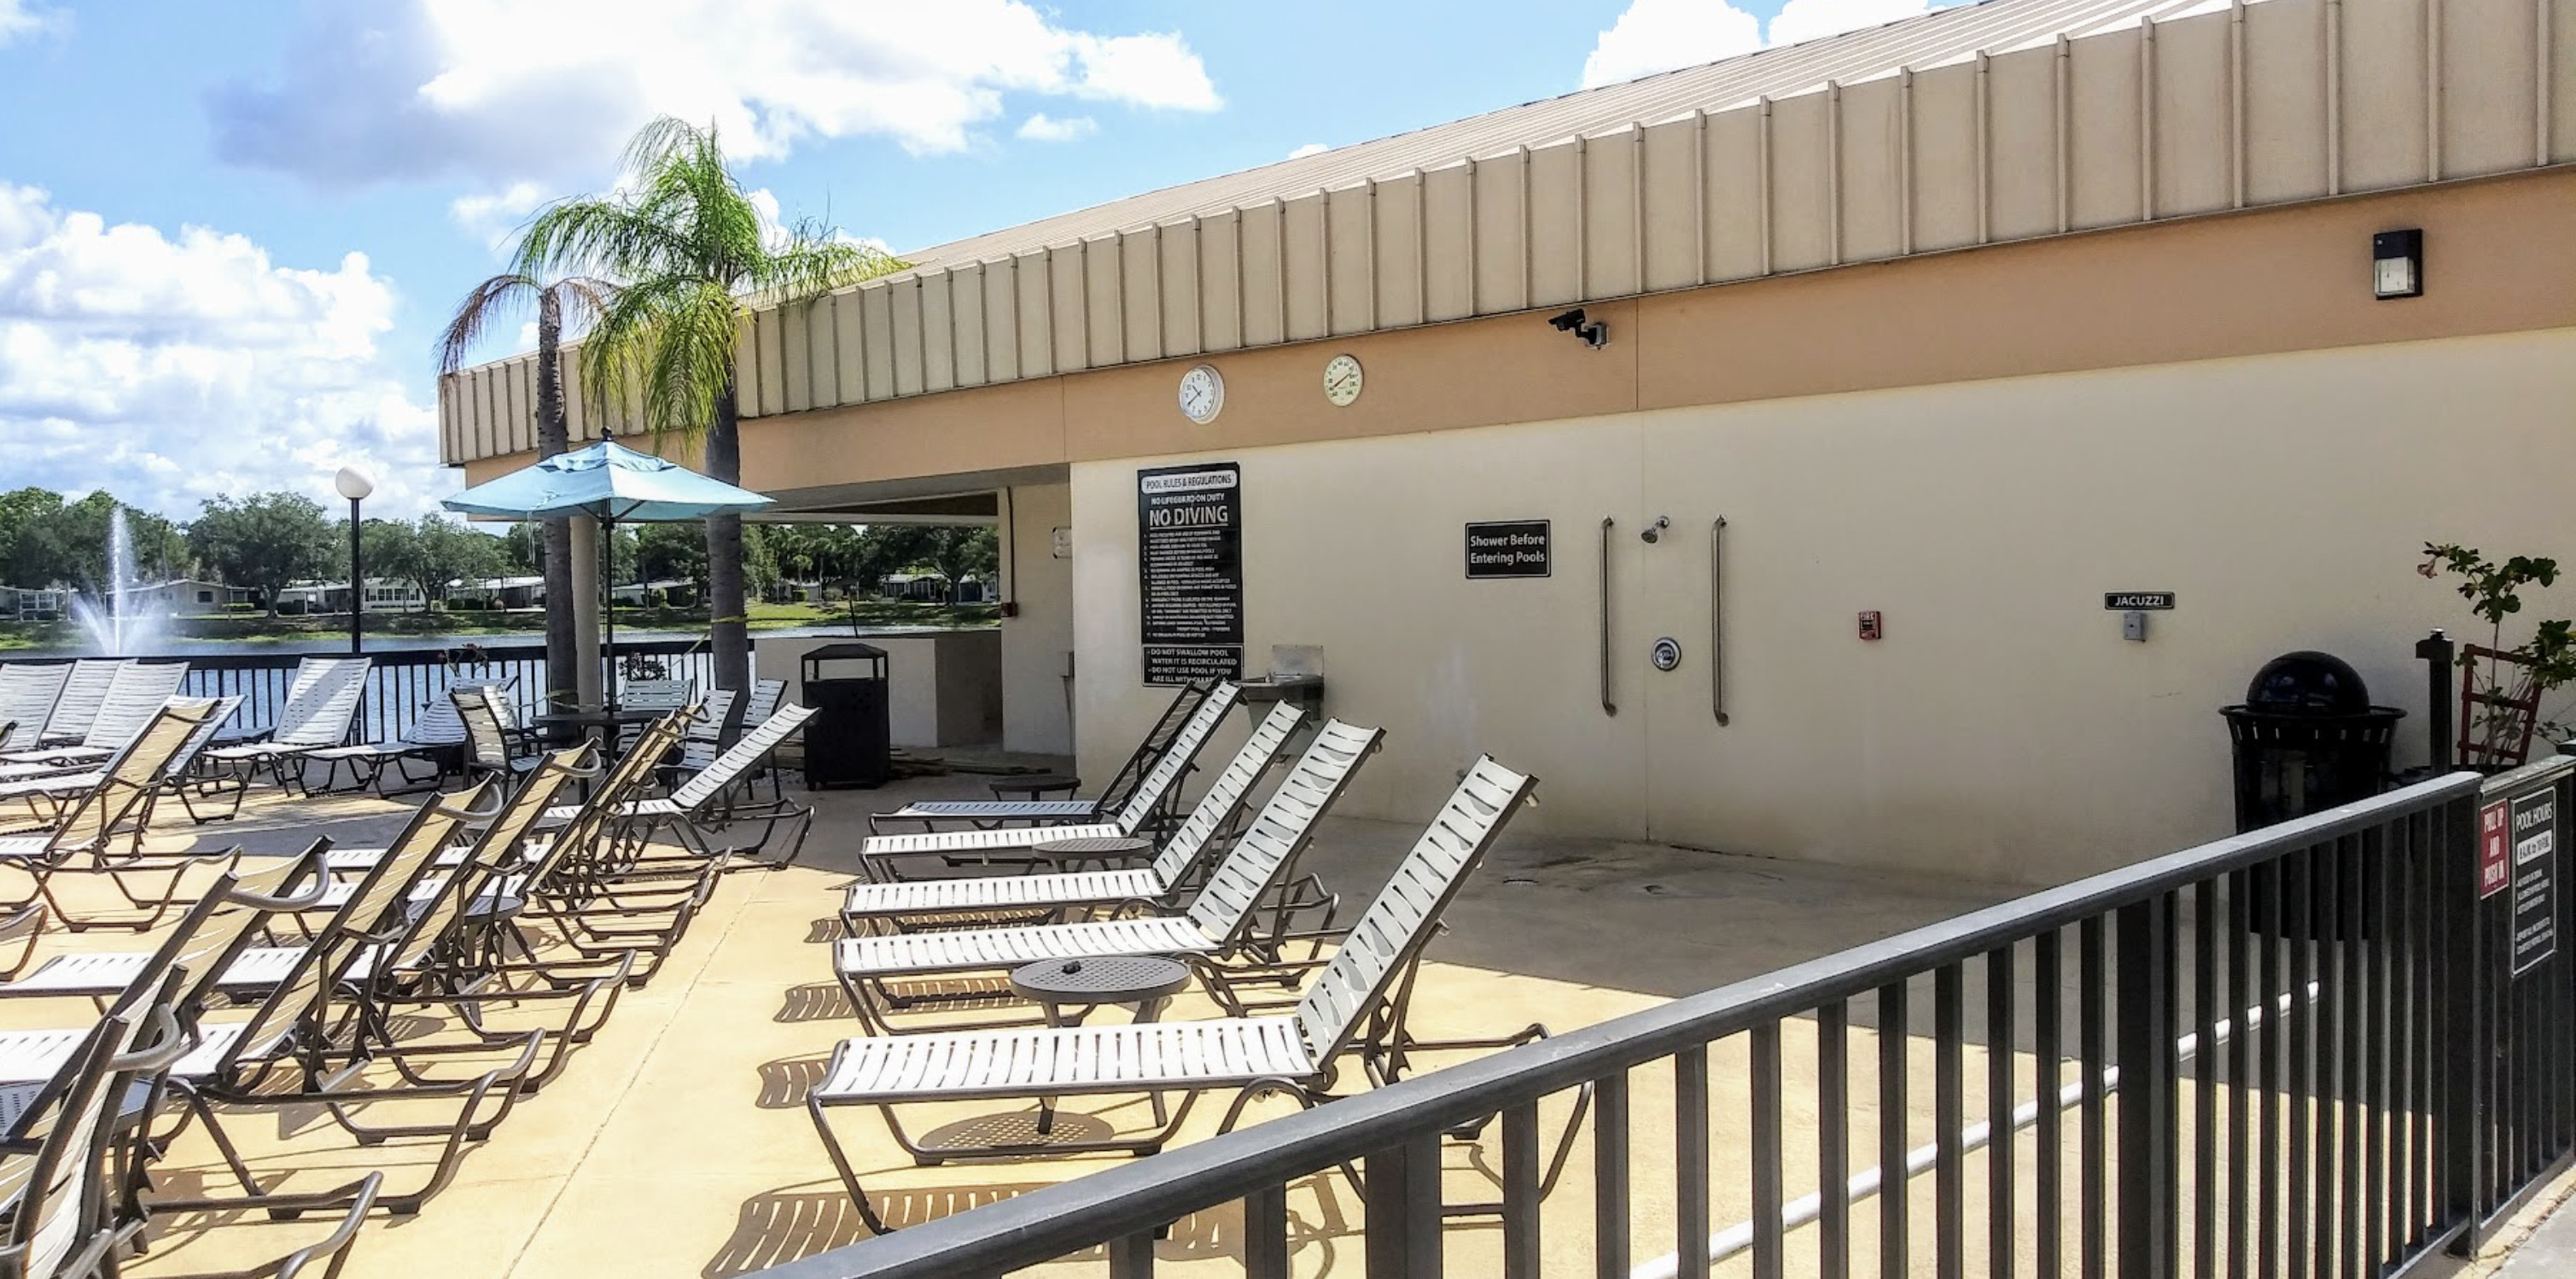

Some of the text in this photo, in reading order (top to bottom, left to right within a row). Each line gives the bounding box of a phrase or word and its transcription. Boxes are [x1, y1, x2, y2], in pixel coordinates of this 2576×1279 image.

[1146, 479, 1162, 489] POOL
[1163, 478, 1182, 488] RULES
[1188, 474, 1233, 487] REGULATIONS
[1151, 493, 1225, 505] NO LIFEGUARD ON DUTY
[1149, 505, 1228, 527] NO DIVING
[1470, 533, 1545, 546] Shower Before
[1470, 550, 1545, 566] Entering Pools
[2114, 595, 2165, 606] JACUZZI
[2515, 802, 2552, 832] POOL HOURS
